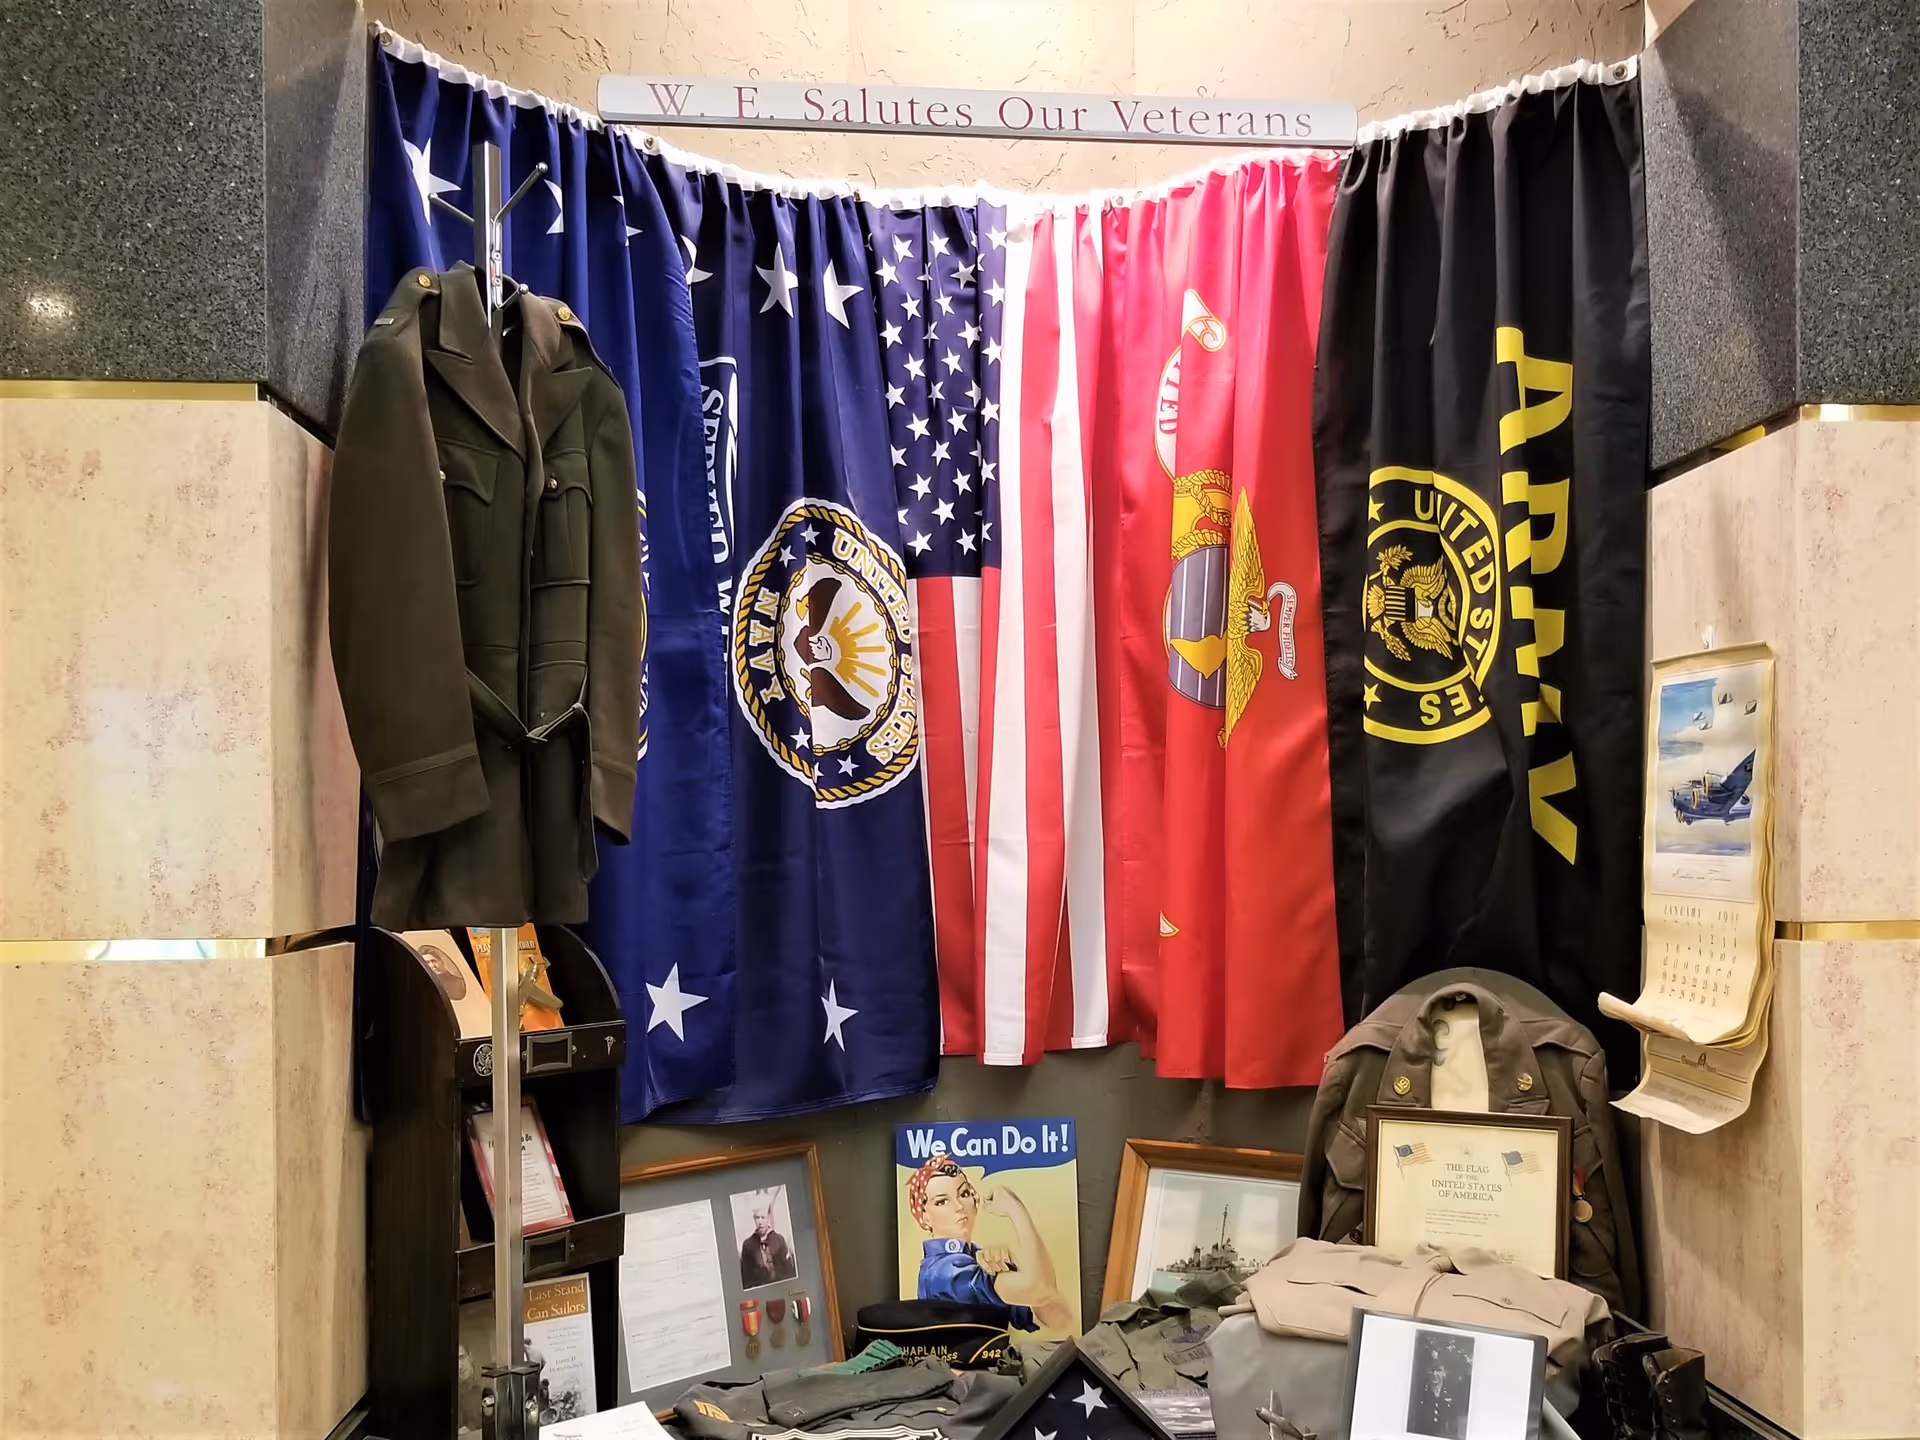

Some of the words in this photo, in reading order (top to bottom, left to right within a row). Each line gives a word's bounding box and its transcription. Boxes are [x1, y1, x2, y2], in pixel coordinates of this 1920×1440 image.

[647, 82, 706, 118] W.
[734, 85, 776, 120] E.
[803, 87, 973, 129] Salutes
[999, 95, 1088, 133] Our
[1110, 100, 1312, 138] Veterans
[1282, 593, 1295, 629] SEMPER
[748, 586, 786, 705] NAVY
[1282, 631, 1294, 667] FIDELIS
[905, 1128, 947, 1159] We
[950, 1127, 997, 1157] Can
[1002, 1125, 1037, 1155] Do
[1042, 1123, 1069, 1153] It!
[1446, 1163, 1464, 1172] THE
[1466, 1164, 1489, 1173] FLAG
[1432, 1180, 1465, 1189] UNITED
[1468, 1182, 1502, 1192] STATES
[1438, 1189, 1451, 1198] OF
[1453, 1192, 1494, 1201] AMERICA
[529, 1288, 552, 1302] Last
[554, 1279, 585, 1297] Stand
[527, 1307, 549, 1320] Can
[551, 1300, 586, 1317] Sailors
[981, 1349, 1002, 1360] 942
